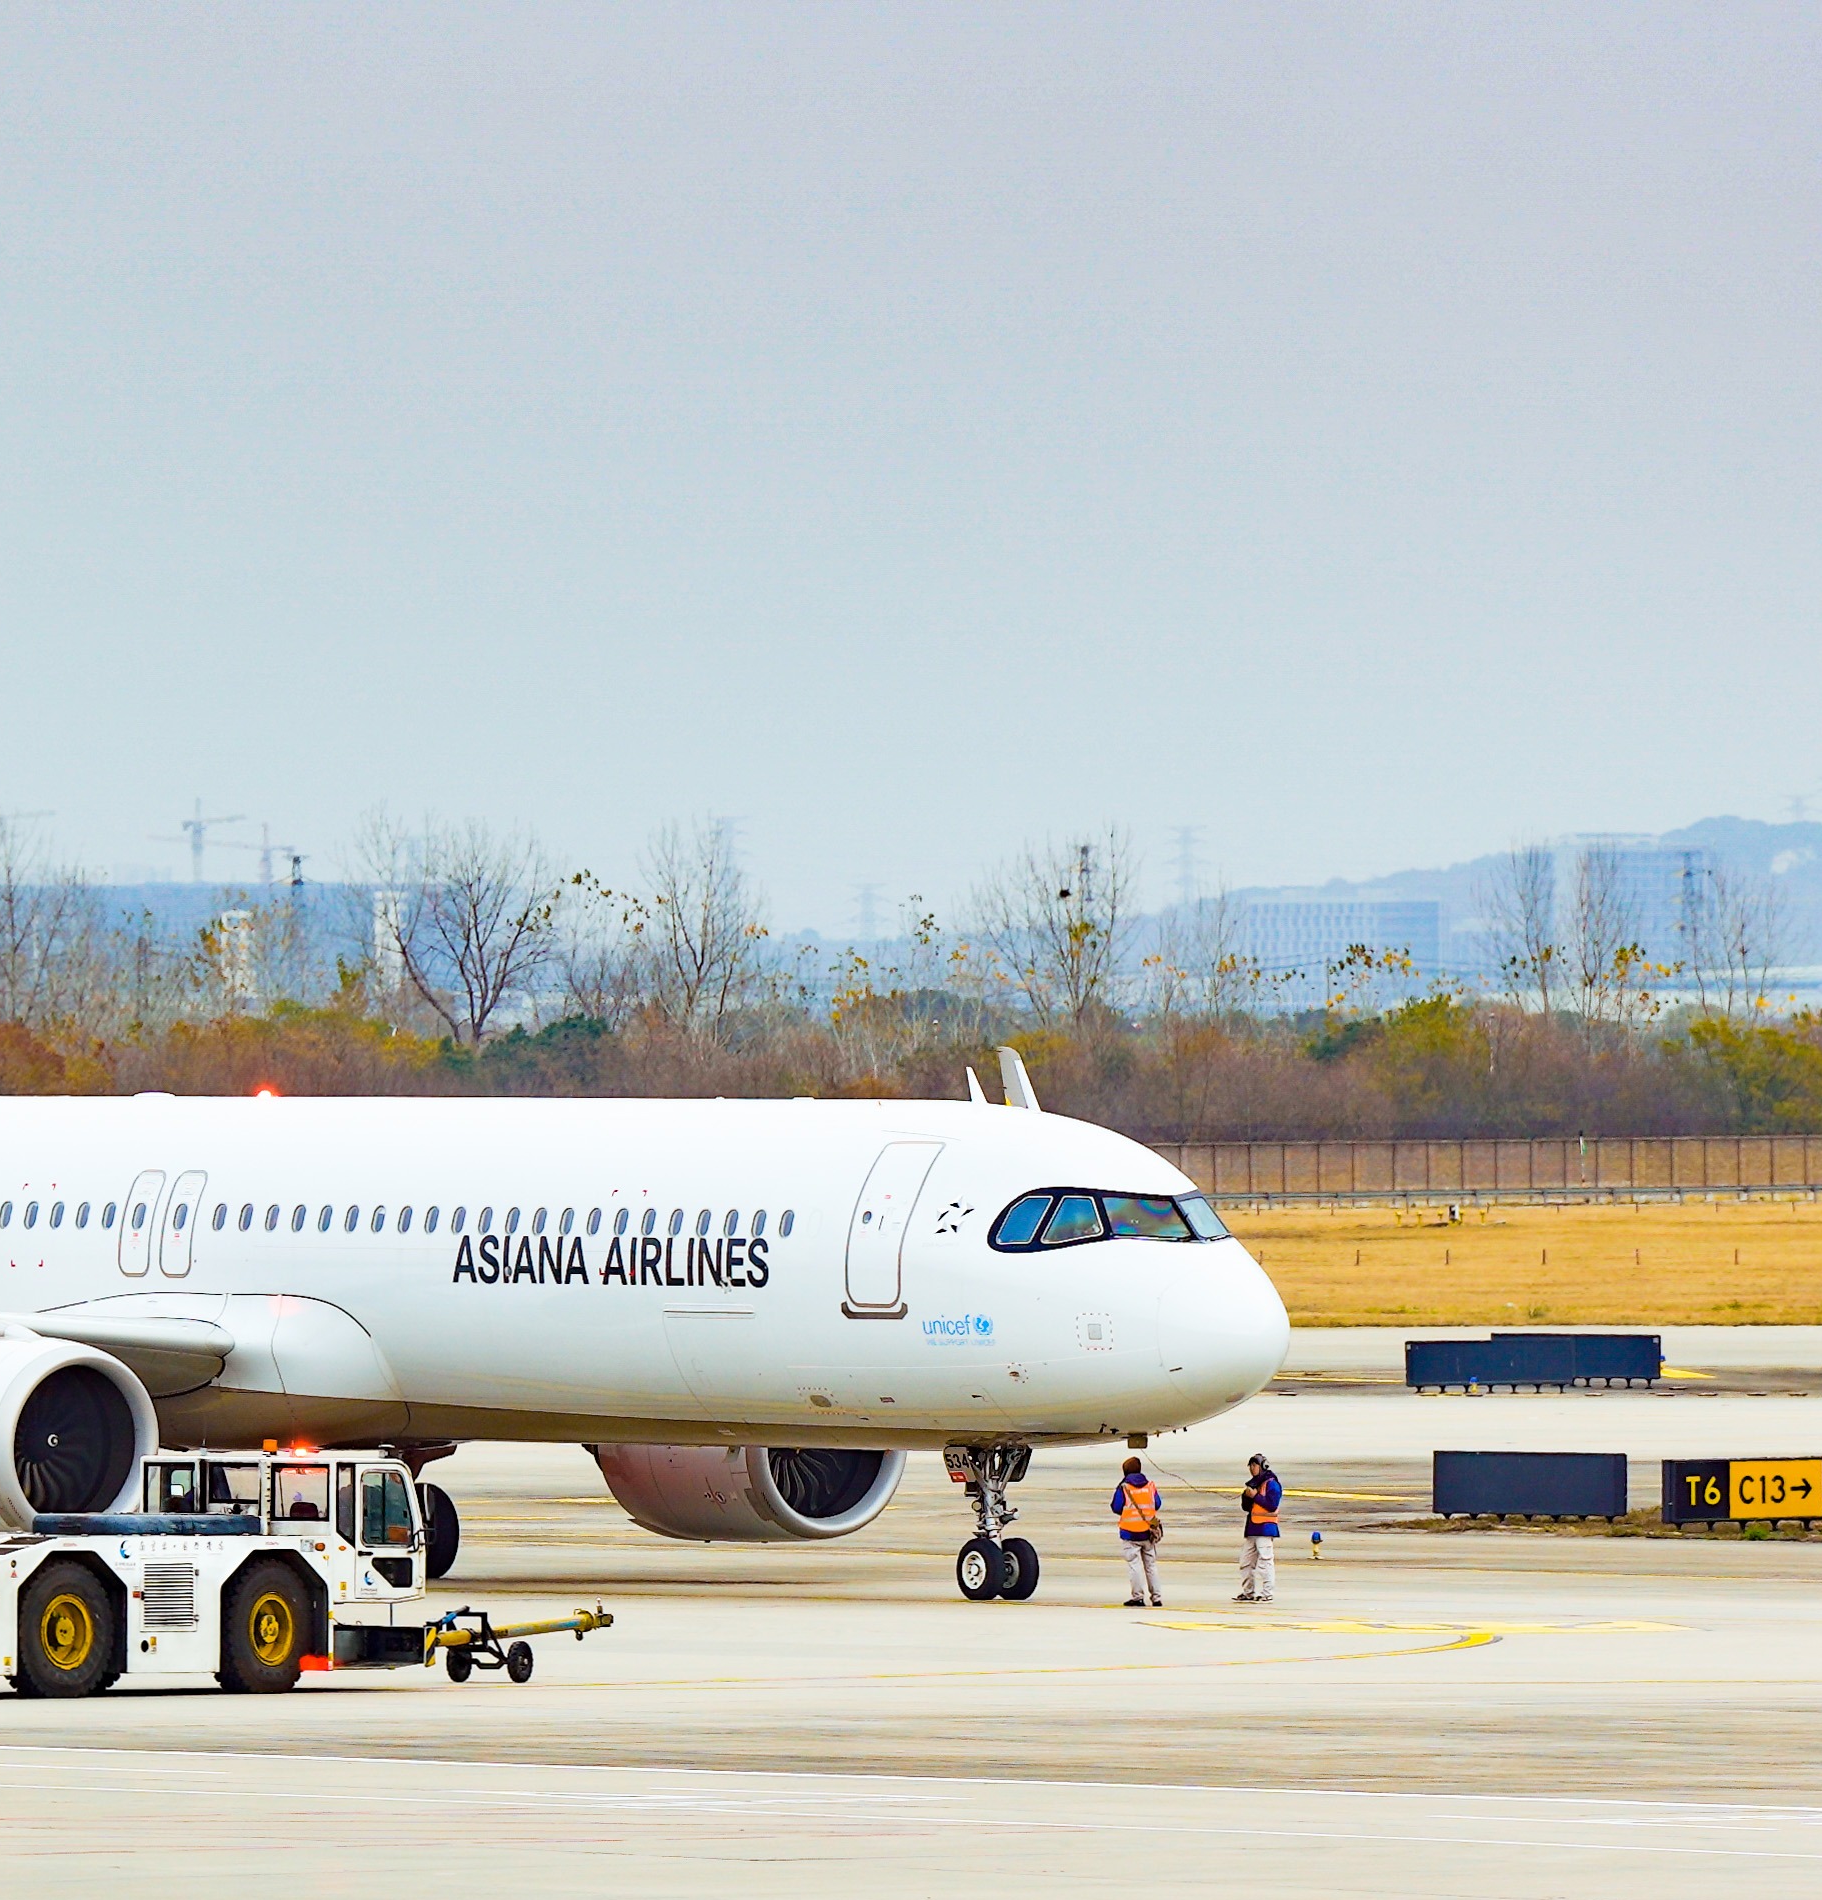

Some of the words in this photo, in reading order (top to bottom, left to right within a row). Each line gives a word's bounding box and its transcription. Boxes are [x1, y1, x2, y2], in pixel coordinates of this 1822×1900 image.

[452, 1234, 590, 1285] ASIANA
[601, 1236, 770, 1289] AIRLINES
[922, 1313, 971, 1336] unicef
[945, 1453, 970, 1469] 534
[1685, 1475, 1721, 1506] T6
[1739, 1475, 1786, 1505] C13
